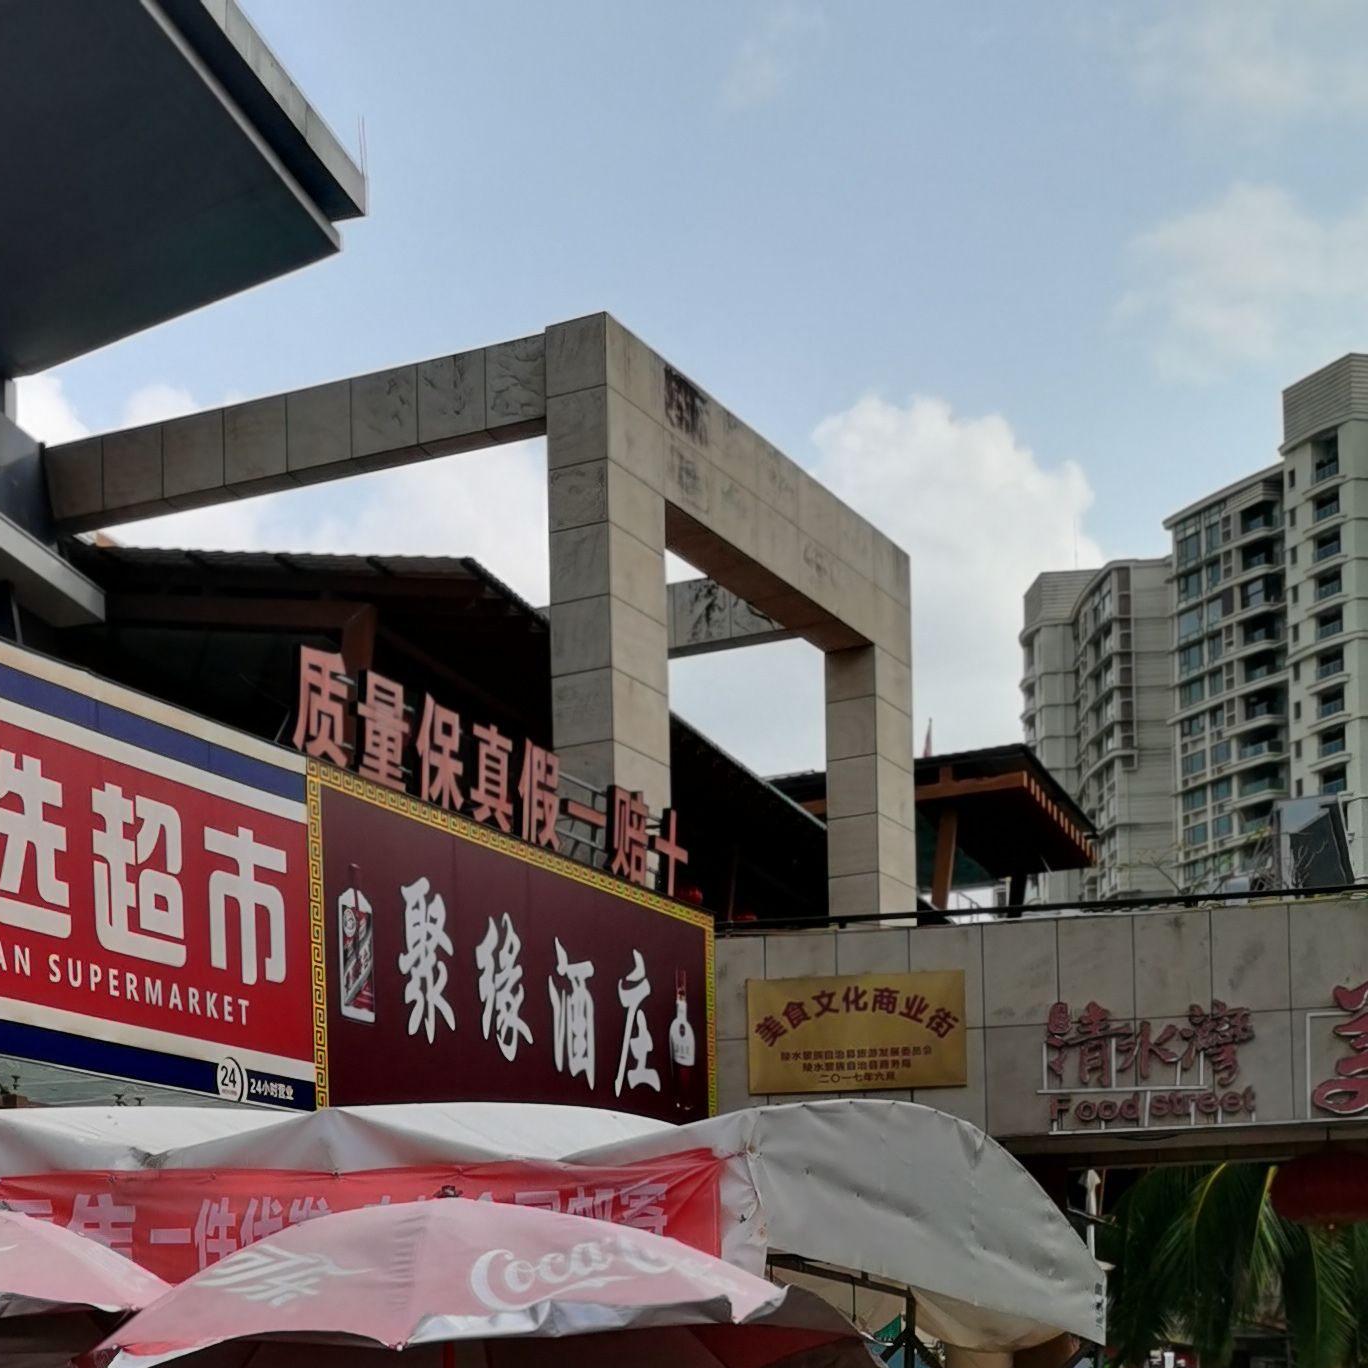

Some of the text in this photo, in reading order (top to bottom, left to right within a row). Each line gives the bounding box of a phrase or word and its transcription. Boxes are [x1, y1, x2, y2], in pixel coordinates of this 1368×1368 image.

[293, 644, 689, 896] 质量保真假一赔十
[48, 955, 250, 1026] SUPERMARKET
[398, 876, 661, 1097] 聚缘酒庄
[755, 986, 959, 1046] 美食文化商业街
[220, 1066, 237, 1088] 24
[1051, 1091, 1141, 1122] Food
